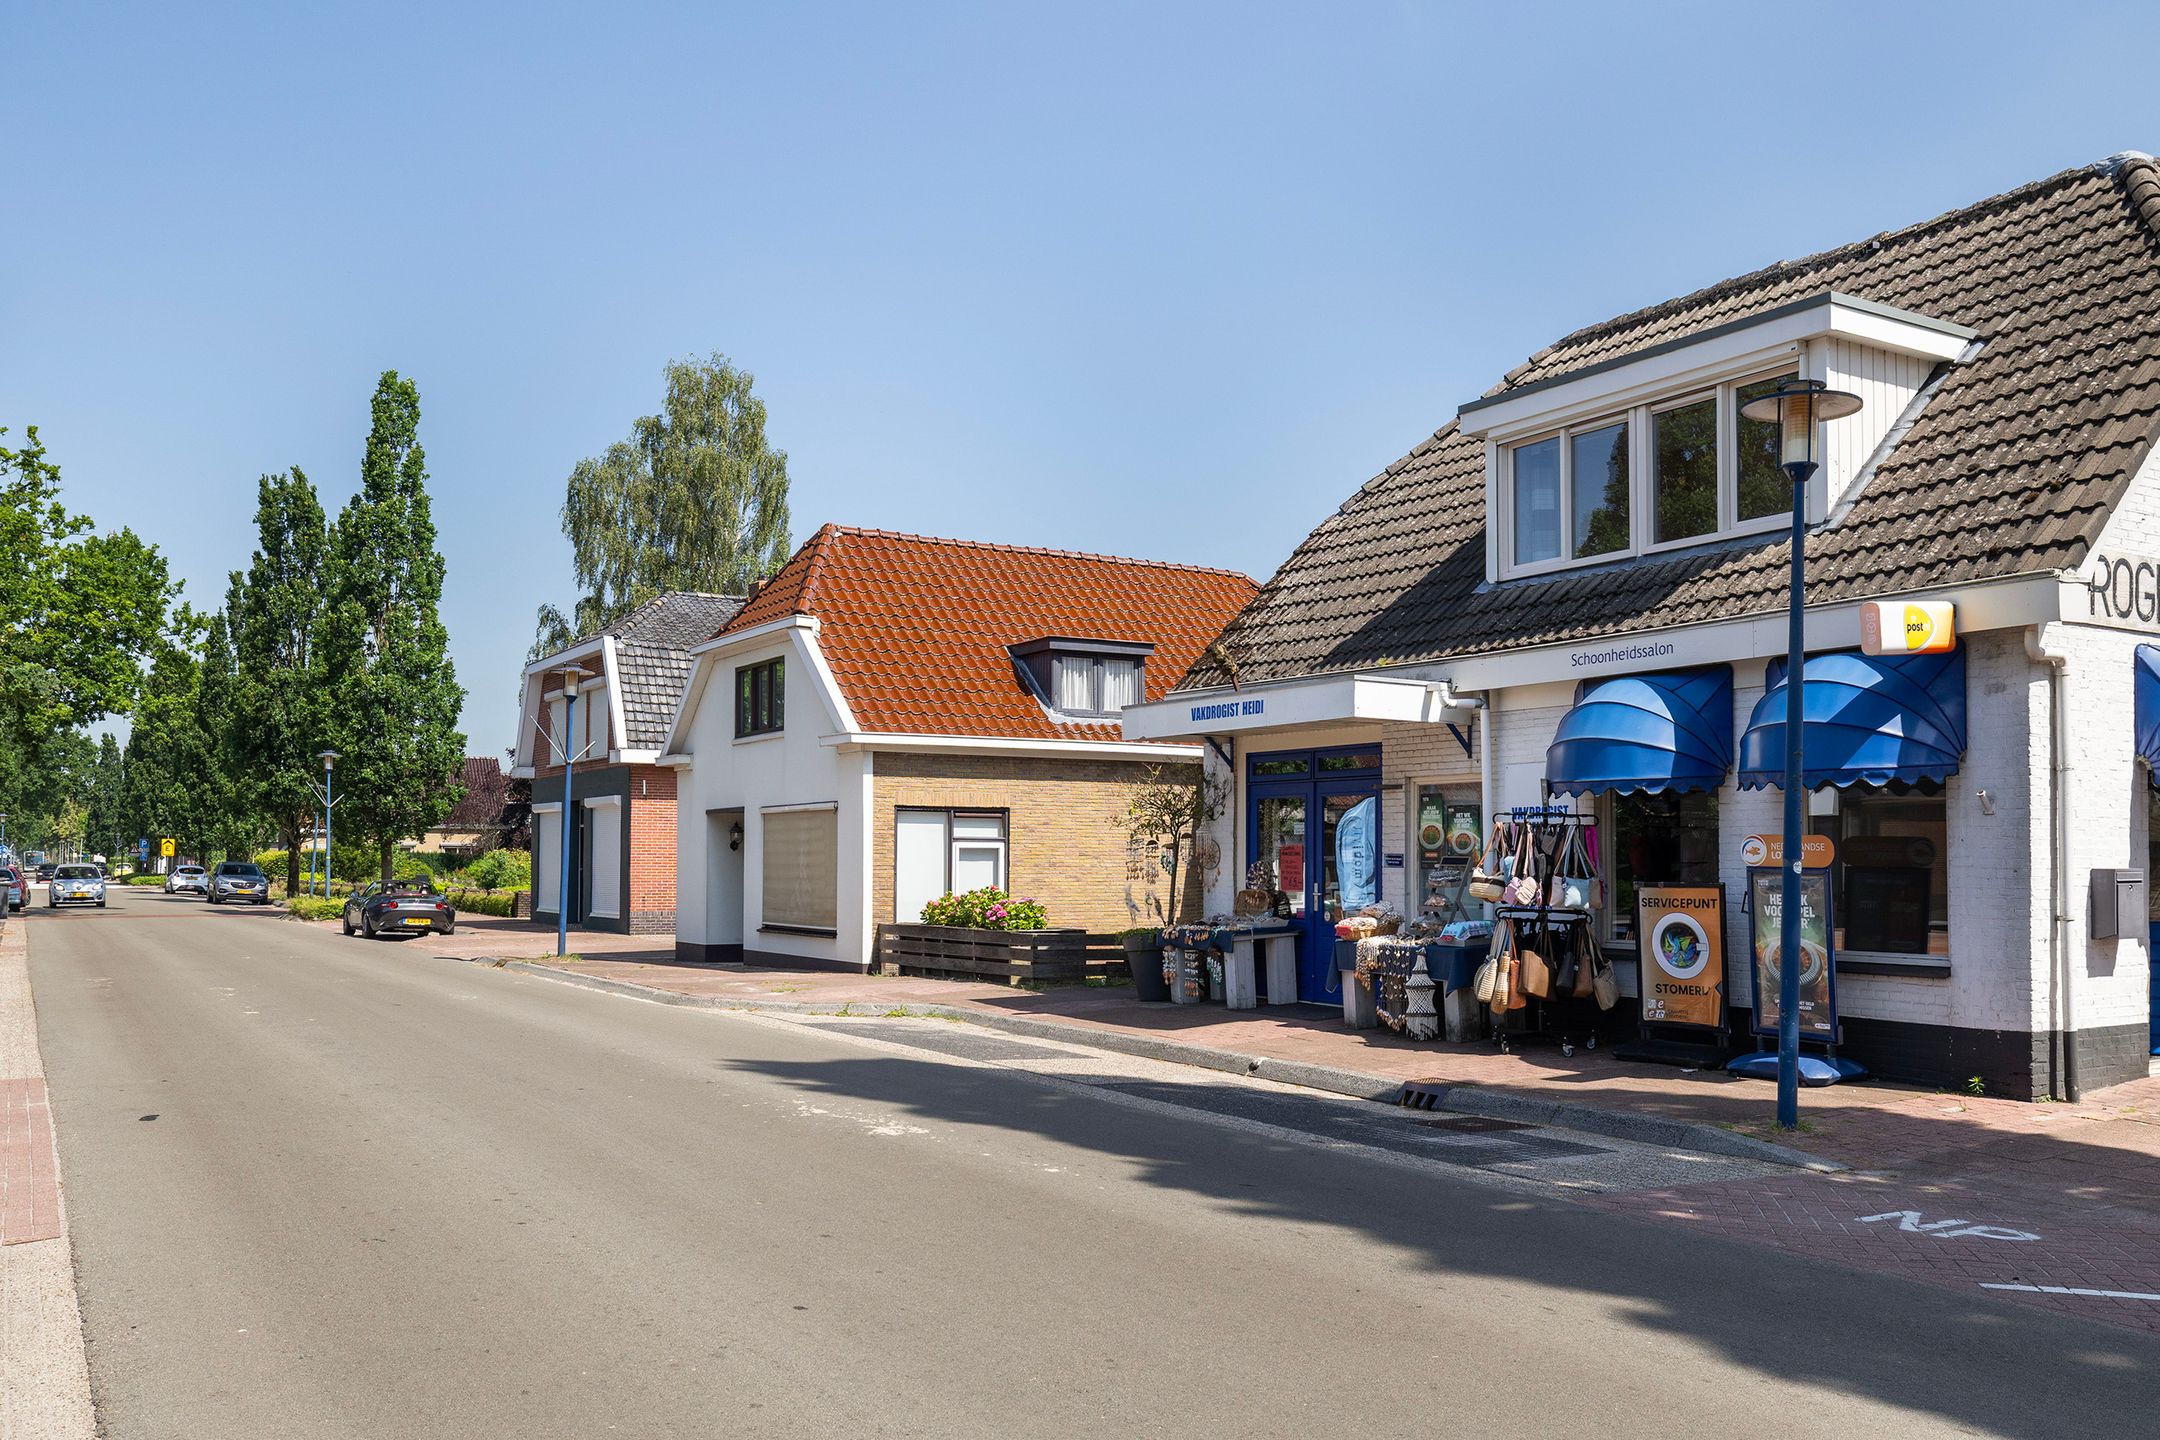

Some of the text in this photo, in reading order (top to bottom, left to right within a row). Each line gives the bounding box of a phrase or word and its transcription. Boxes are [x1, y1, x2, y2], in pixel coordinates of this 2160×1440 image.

[1571, 642, 1674, 667] Schoonheidssalon
[1190, 699, 1264, 721] VAKDROGIST HEIDI
[1511, 804, 1569, 820] VAKDRGIST
[1770, 842, 1825, 851] NEANDSE
[1641, 897, 1718, 909] SERVICEPUNT
[1764, 905, 1816, 918] VOOEL
